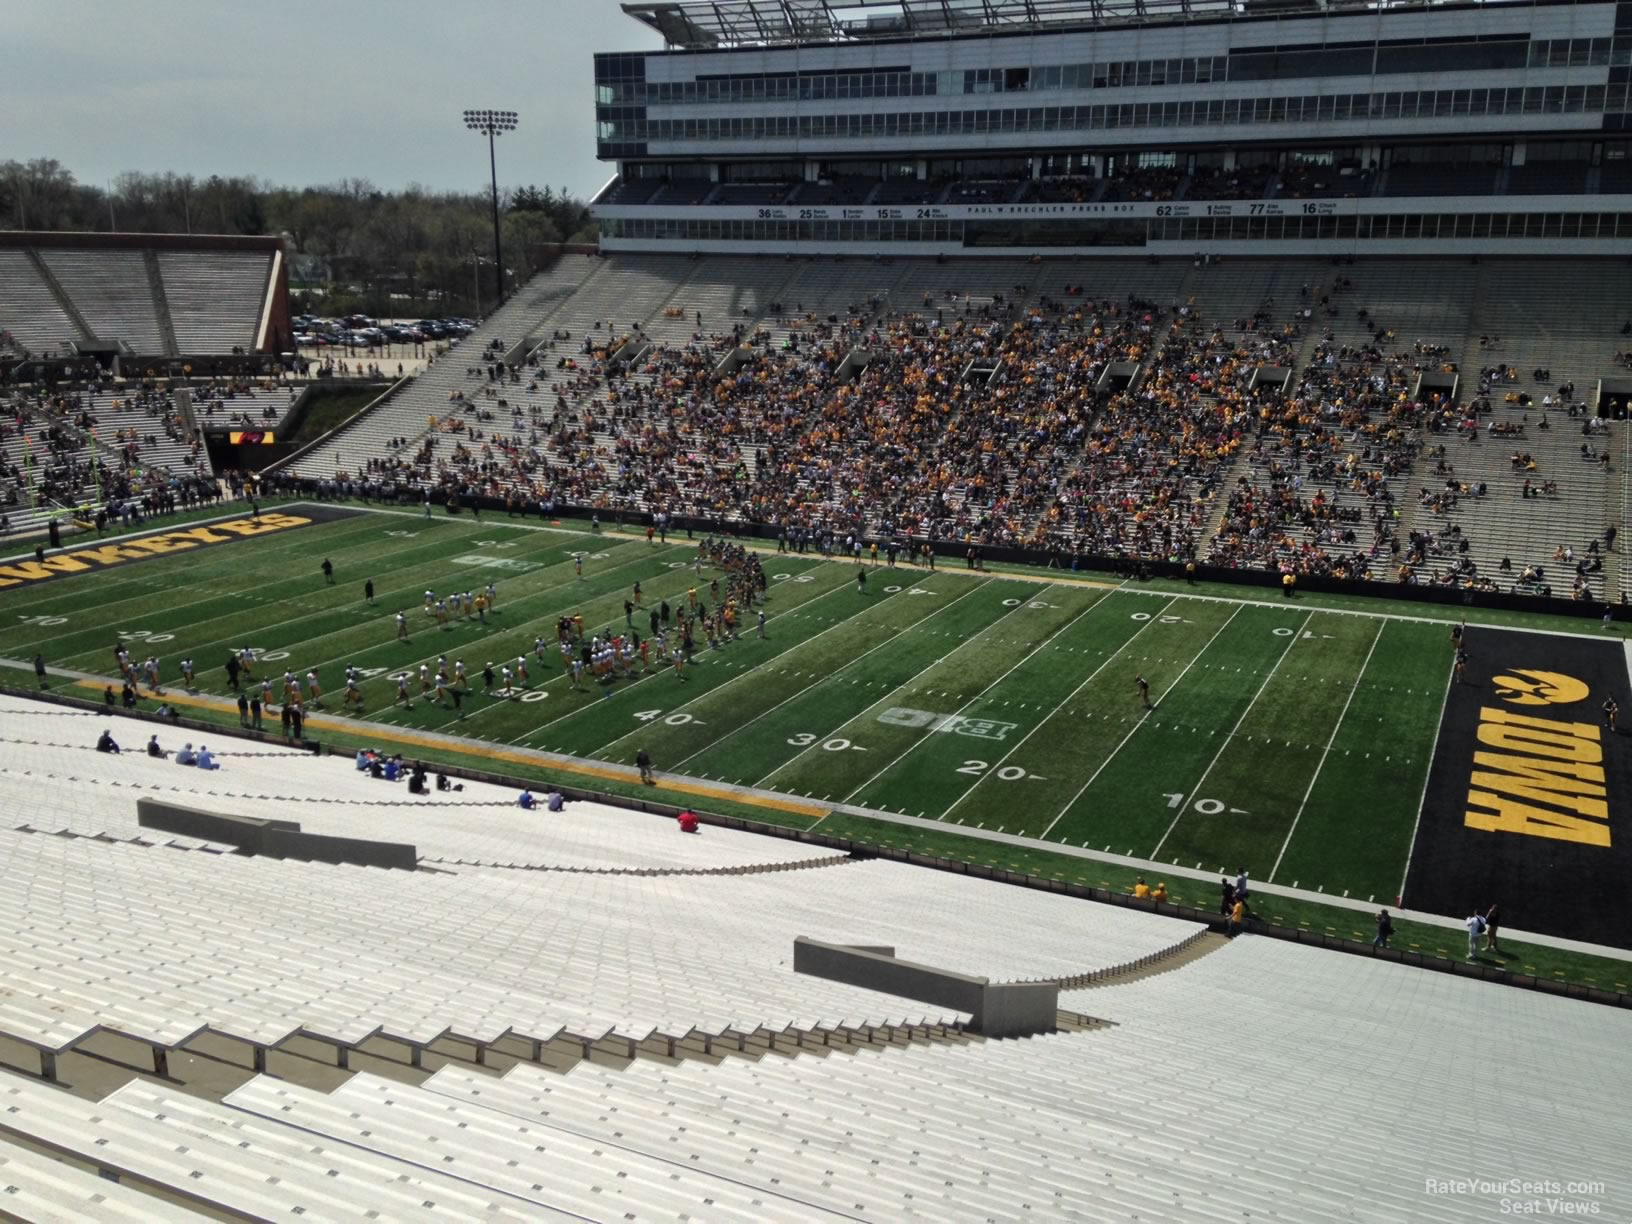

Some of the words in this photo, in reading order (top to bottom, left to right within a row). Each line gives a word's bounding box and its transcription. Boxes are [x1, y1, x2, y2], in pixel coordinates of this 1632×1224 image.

[758, 208, 771, 218] 36
[800, 208, 812, 218] 25
[842, 208, 847, 218] 1
[877, 208, 888, 218] 15
[917, 208, 930, 218] 24
[1156, 205, 1172, 216] 62
[1207, 205, 1212, 215] 1
[1250, 203, 1265, 214] 77
[1302, 203, 1317, 214] 16
[0, 513, 312, 587] WKEYES
[632, 708, 693, 726] 40
[786, 732, 852, 752] 30
[955, 759, 1027, 781] 20
[1464, 706, 1613, 848] IOWA
[1161, 792, 1226, 815] 10
